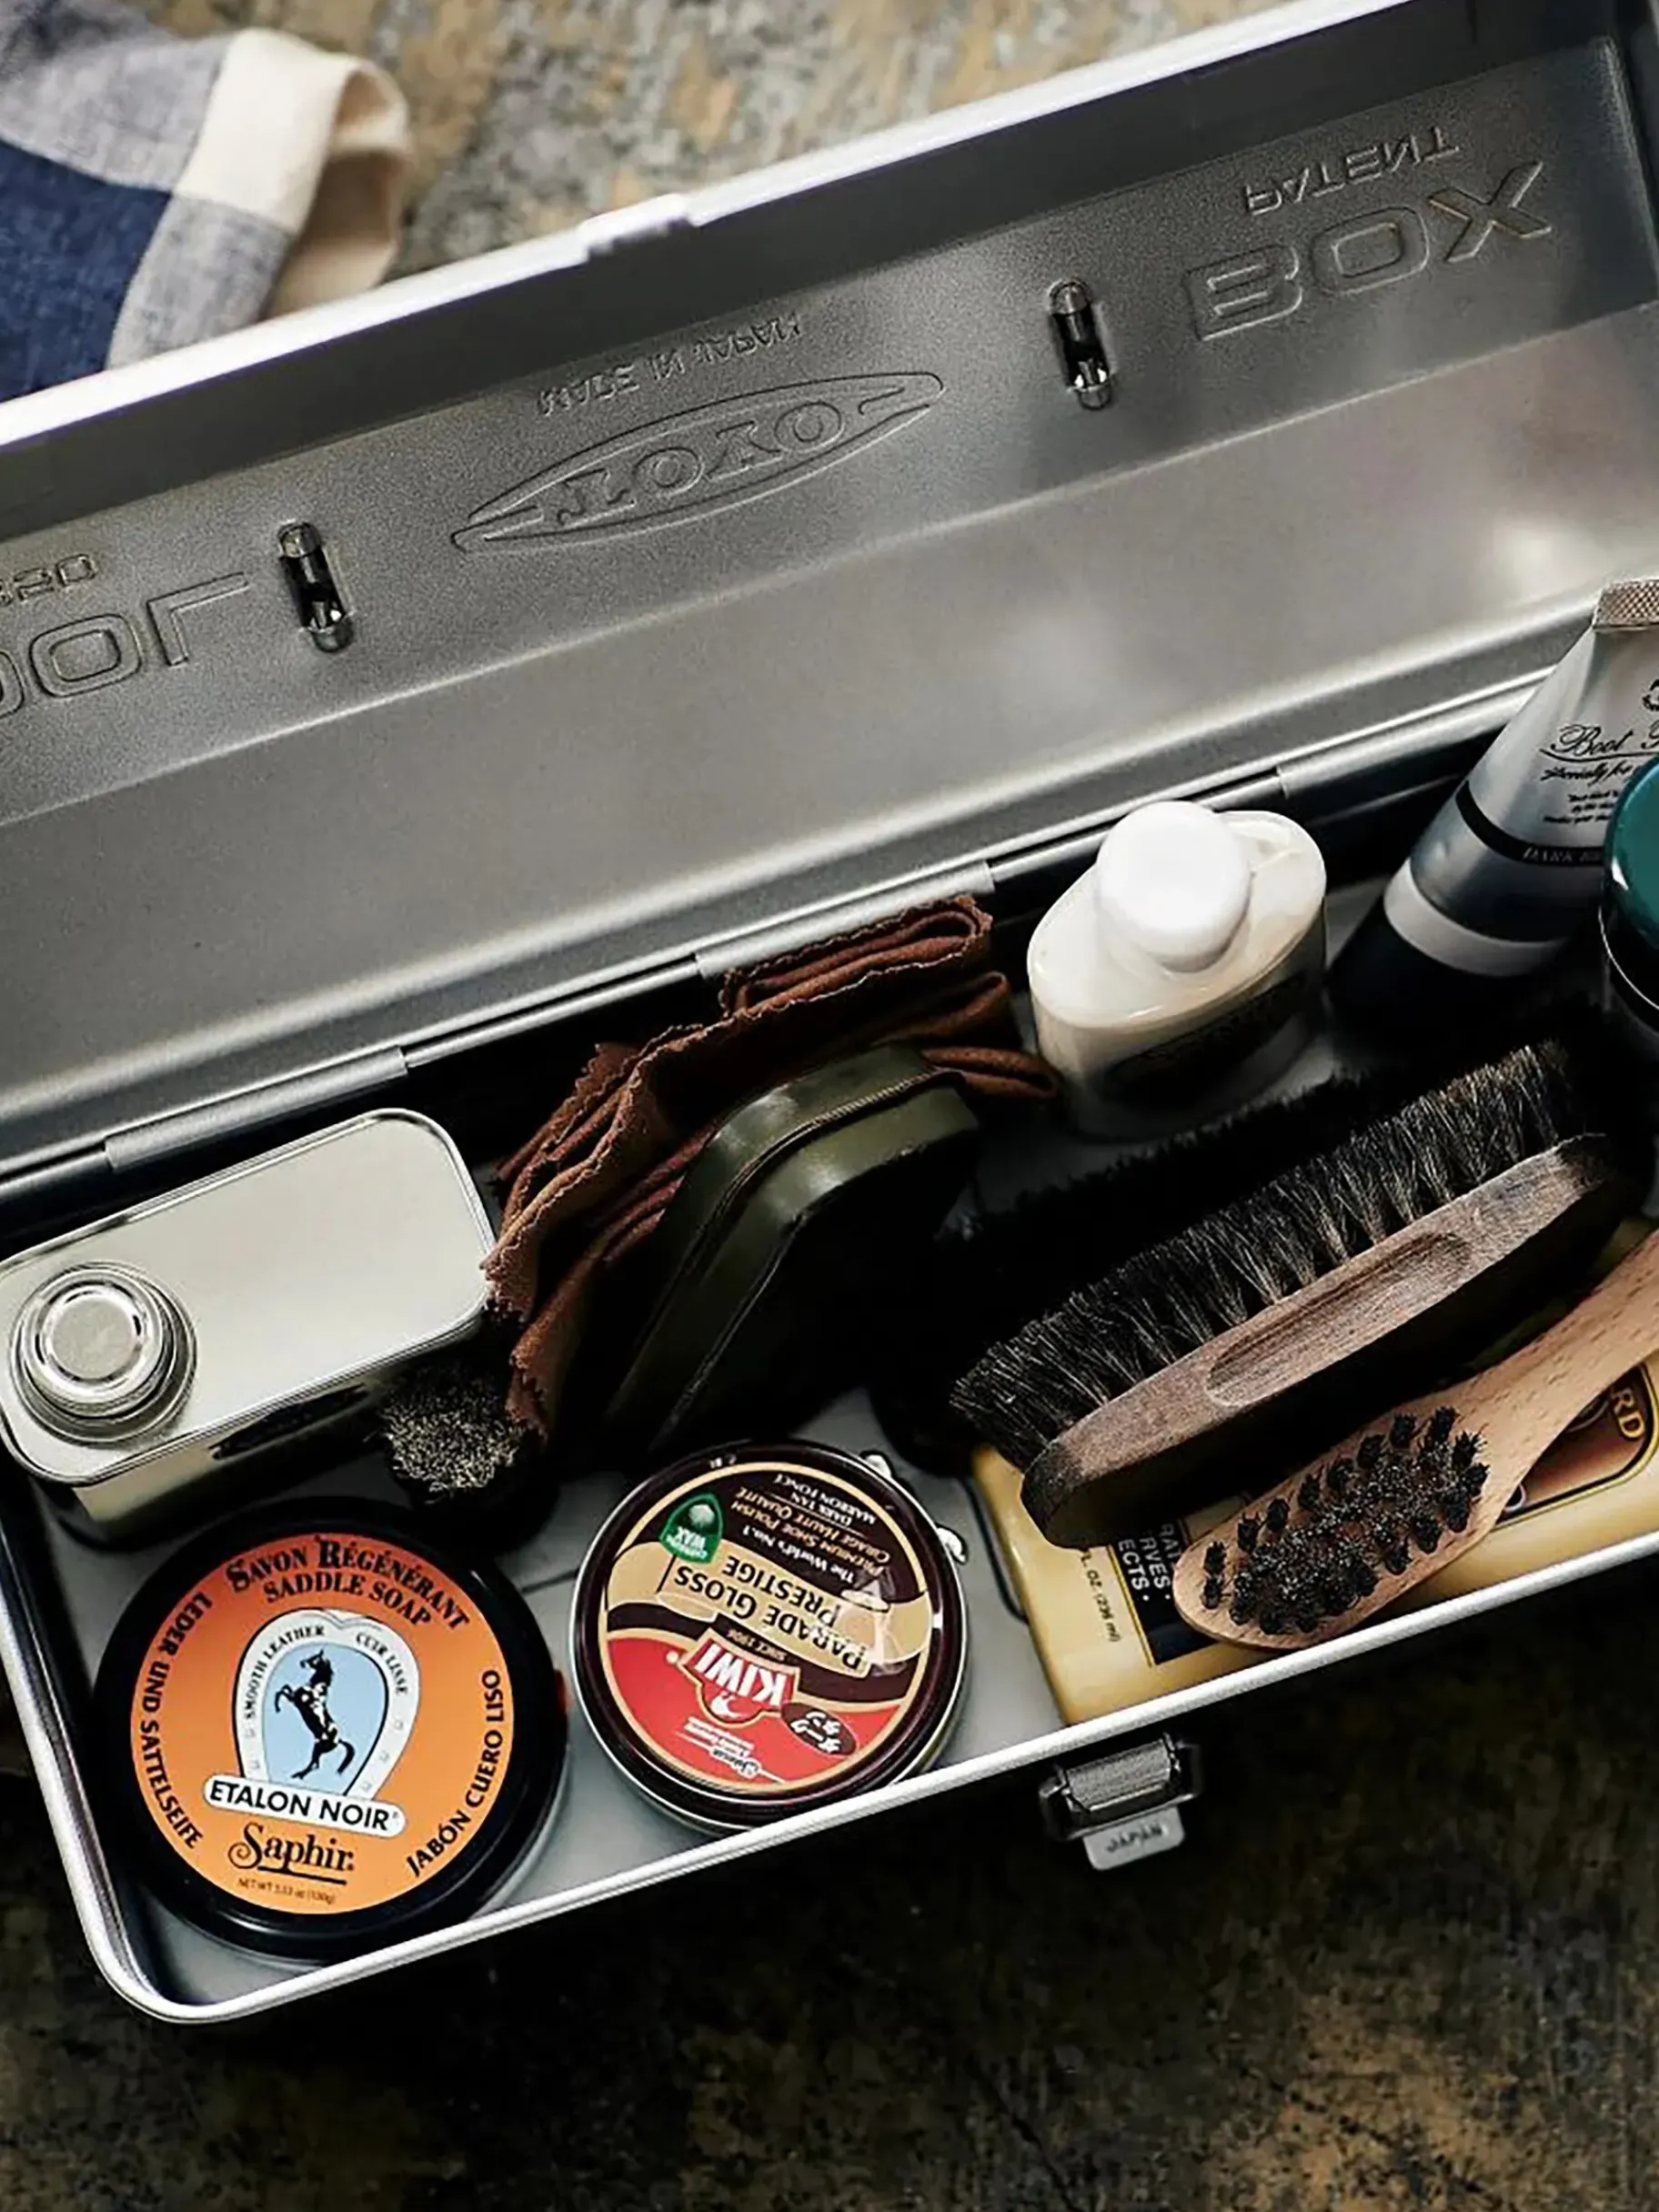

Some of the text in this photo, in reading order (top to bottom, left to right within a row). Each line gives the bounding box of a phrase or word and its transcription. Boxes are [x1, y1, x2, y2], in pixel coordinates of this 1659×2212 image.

[1611, 1385, 1644, 1441] RD
[721, 1554, 841, 1628] PRESTIGE
[1117, 1538, 1151, 1591] ECTS
[1138, 1536, 1172, 1589] RVES
[263, 1570, 432, 1626] SADDLE SOAP
[673, 1564, 868, 1670] PARADE GLOSS
[245, 1624, 327, 1721] SMOOTH LEATHER
[693, 1642, 788, 1707] KIWI
[139, 1591, 213, 1851] LEDER UND SATTELSEIFE
[209, 1779, 390, 1831] ETALON NOIR
[405, 1668, 506, 1878] JABÓN CUERO LISO
